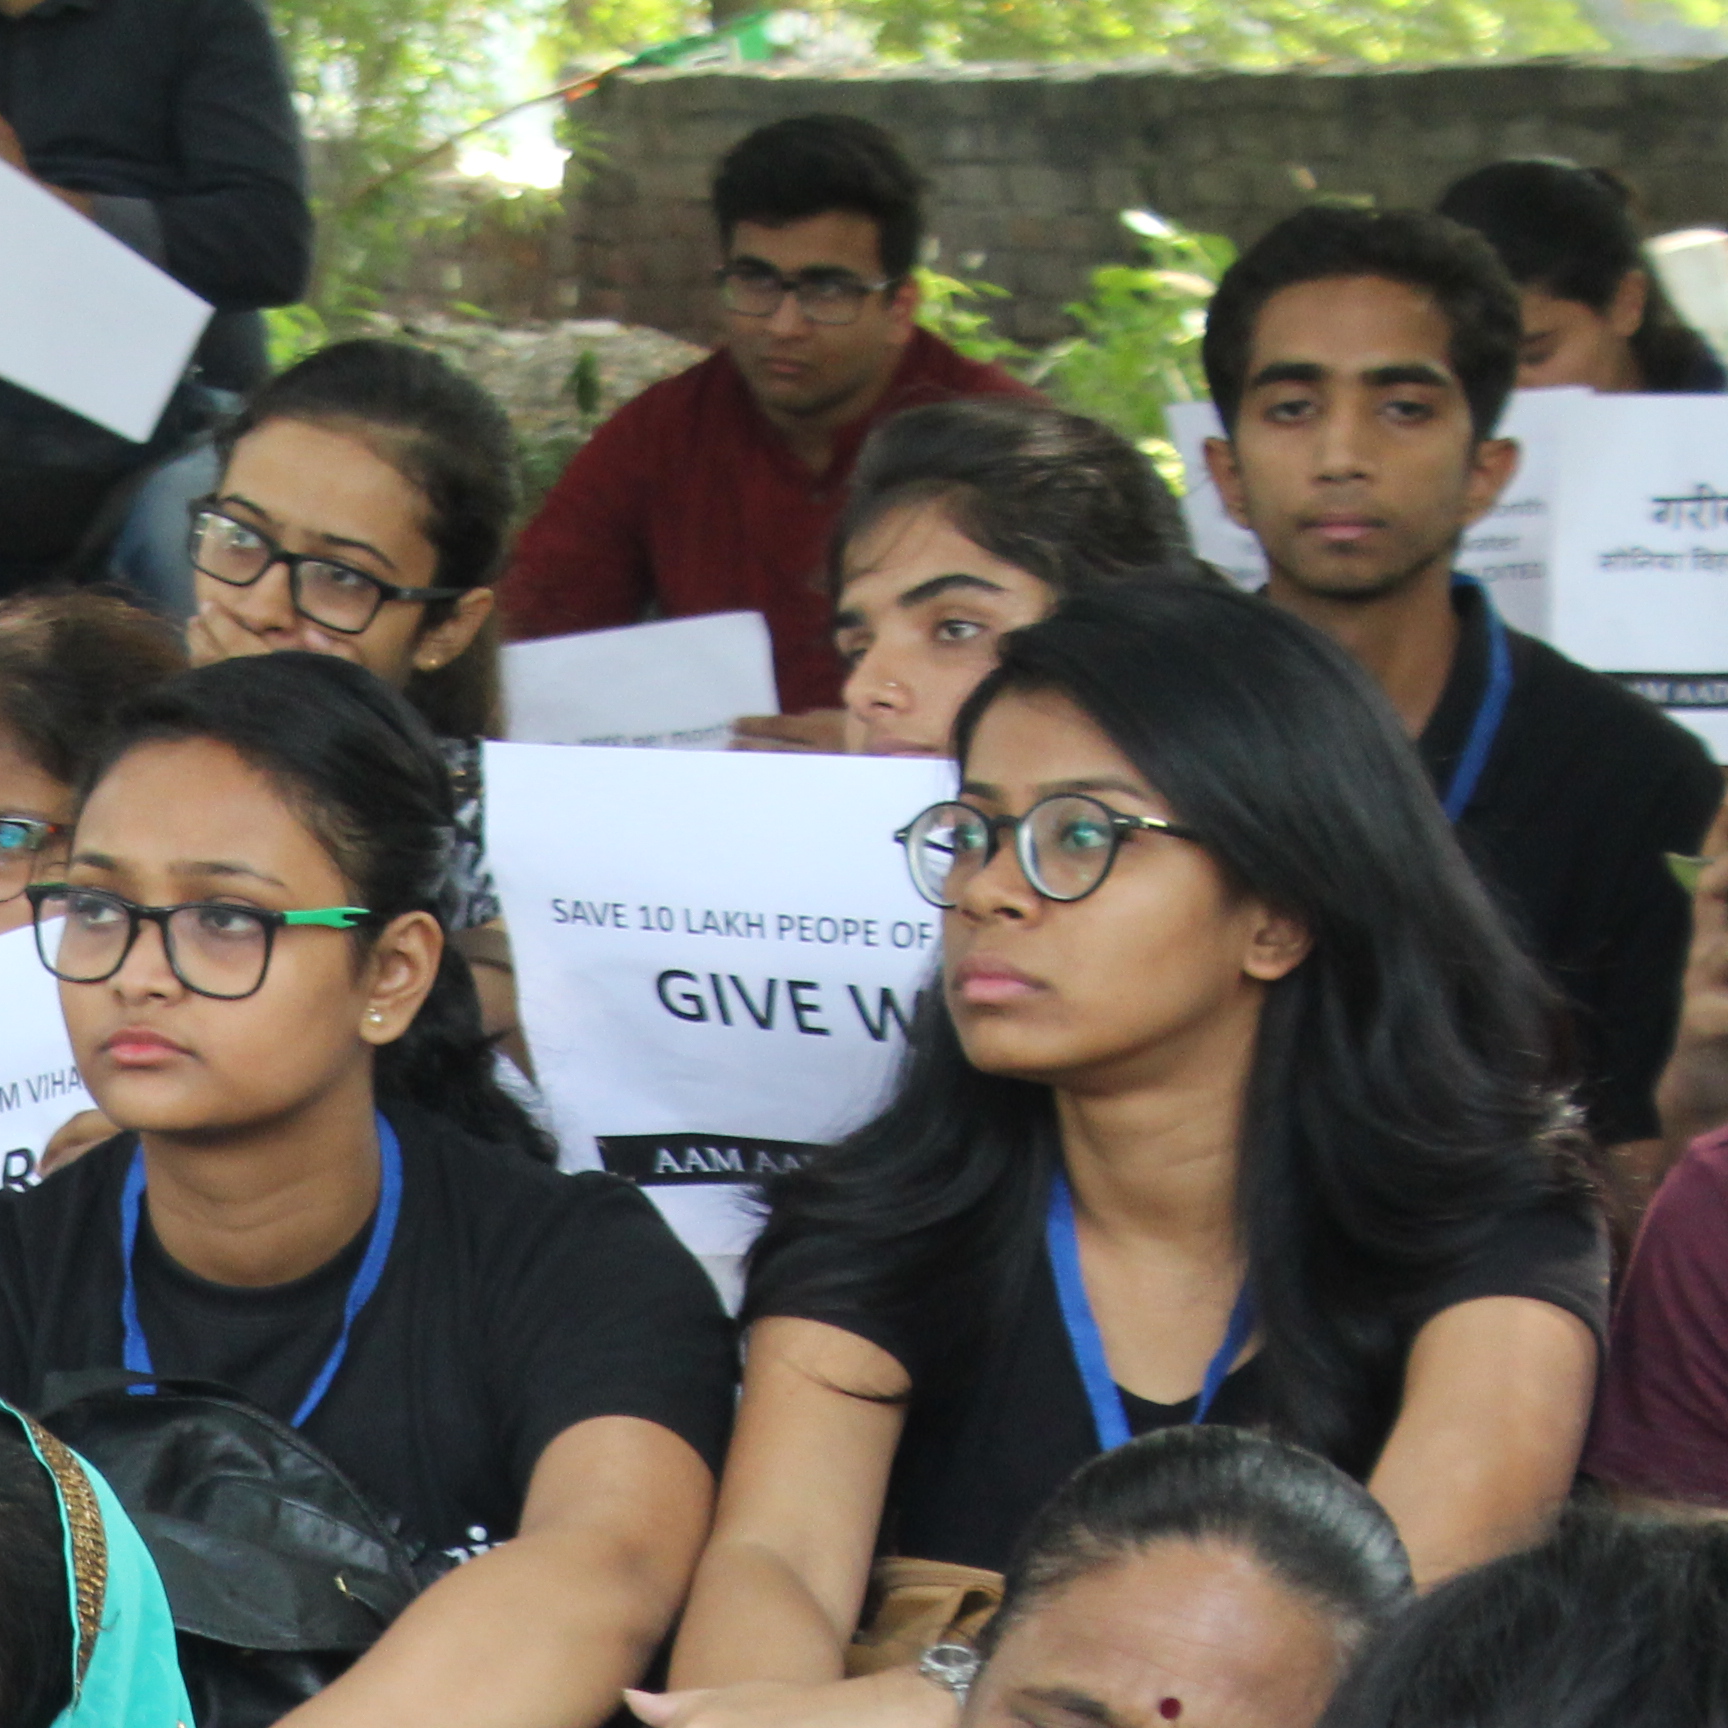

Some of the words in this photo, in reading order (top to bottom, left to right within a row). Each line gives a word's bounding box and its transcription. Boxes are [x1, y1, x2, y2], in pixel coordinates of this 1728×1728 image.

[552, 897, 627, 930] SAVE
[639, 904, 675, 933] 10
[685, 908, 766, 941] LAKH
[777, 914, 880, 949] PEOPE
[891, 920, 935, 951] OF
[655, 967, 832, 1038] GIVE
[25, 1064, 85, 1105] VIHA
[654, 1146, 744, 1177] AAM
